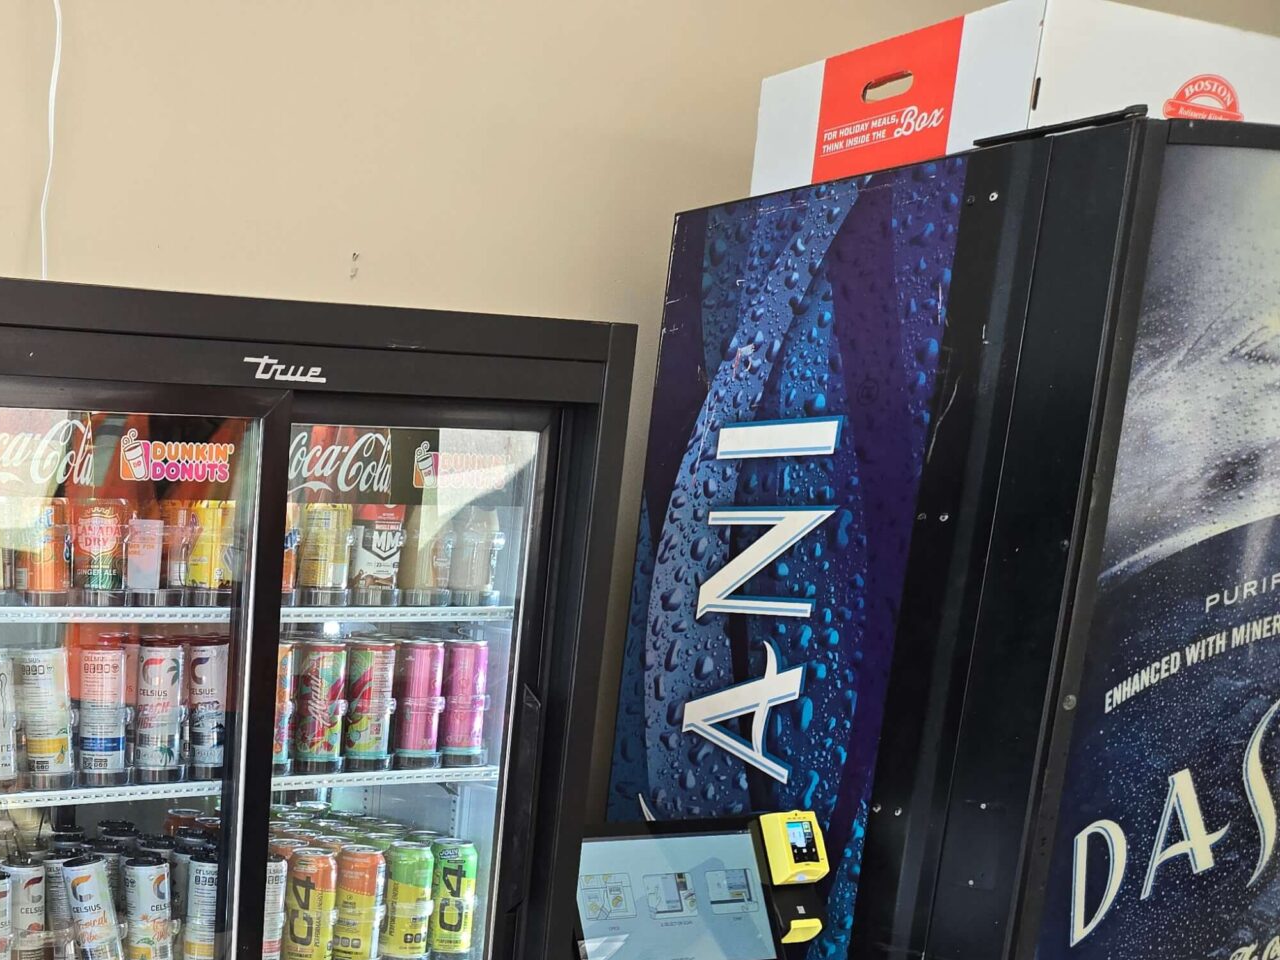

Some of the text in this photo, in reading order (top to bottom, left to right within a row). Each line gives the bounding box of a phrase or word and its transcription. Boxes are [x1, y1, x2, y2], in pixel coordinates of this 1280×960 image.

[1184, 80, 1233, 106] BOSTON
[822, 106, 944, 154] THINK INSIDE THE Box
[824, 115, 898, 141] FOR HOLIDAY MEALS,
[244, 356, 326, 383] true
[150, 441, 234, 463] DUNKIN'
[150, 461, 230, 483] DONUTS
[85, 538, 108, 546] DRY
[682, 420, 840, 785] ANI
[1104, 651, 1182, 714] ENHANCED
[1185, 632, 1226, 666] WITH
[140, 689, 168, 697] CELSIUS
[72, 904, 102, 913] CELSIUS
[289, 876, 315, 946] C4
[439, 865, 466, 932] C4
